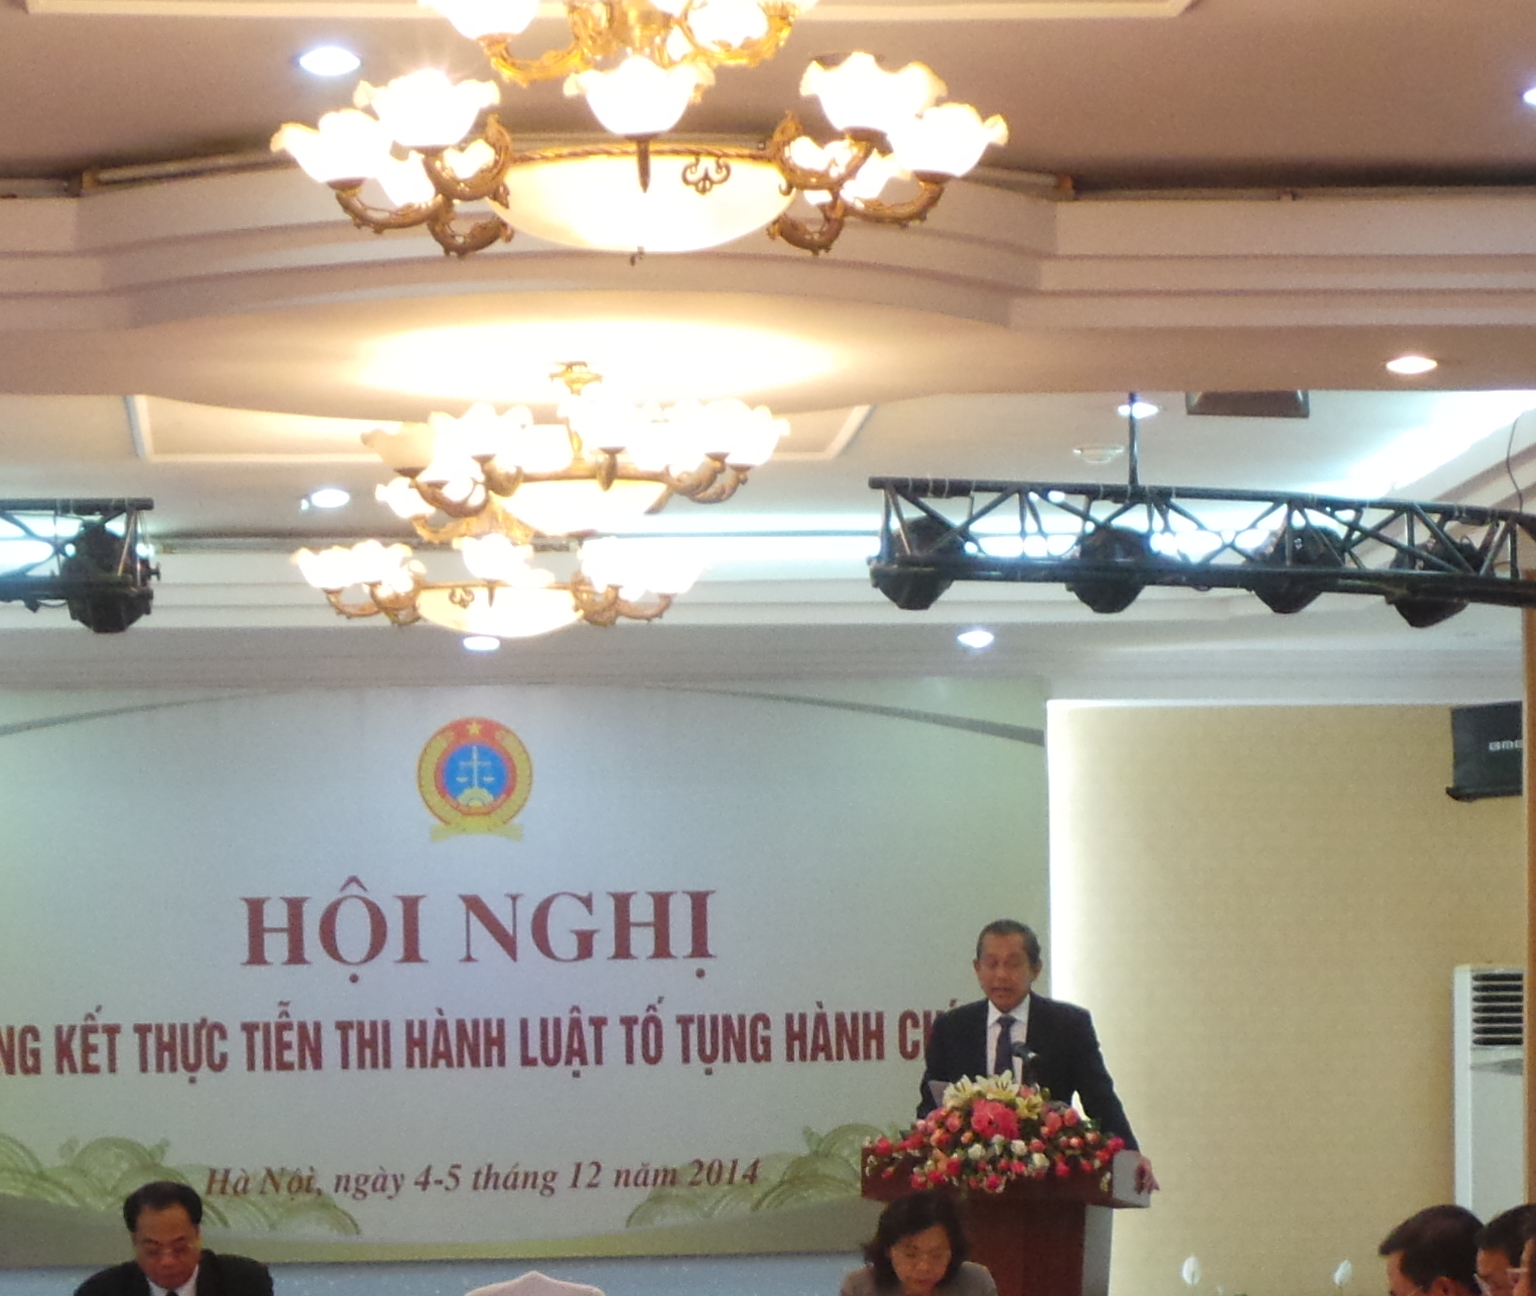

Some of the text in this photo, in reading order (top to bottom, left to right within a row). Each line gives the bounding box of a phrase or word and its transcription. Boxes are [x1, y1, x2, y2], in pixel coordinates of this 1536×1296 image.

[241, 875, 716, 984] HỘI NGHỊ
[54, 1005, 121, 1075] KẾT
[133, 1016, 229, 1085] THỰC
[240, 1000, 323, 1072] TIỄN
[334, 1019, 392, 1070] THI
[405, 1007, 506, 1069] HÀNH
[519, 1005, 608, 1079] LUẬT
[619, 996, 665, 1066] TỐ
[675, 1012, 772, 1076] TỤNG
[785, 1001, 885, 1063] HÀNH
[204, 1157, 761, 1201] Hà Nội, ngày 4-5 tháng 12 năm 2014
